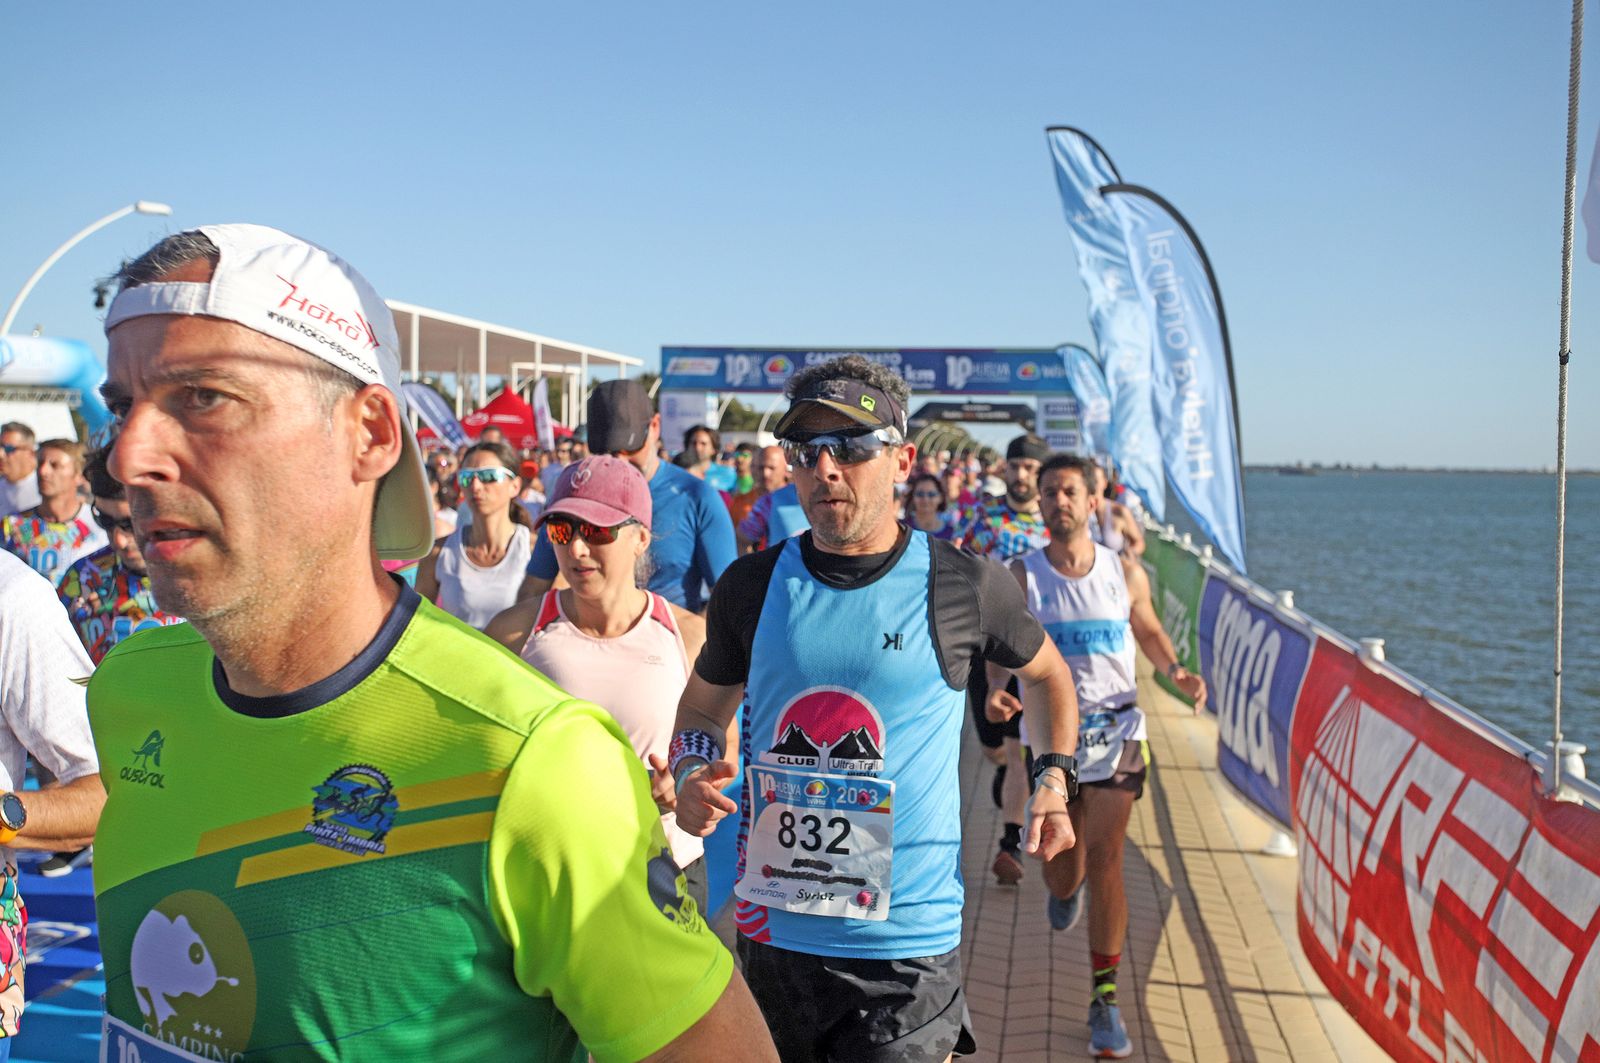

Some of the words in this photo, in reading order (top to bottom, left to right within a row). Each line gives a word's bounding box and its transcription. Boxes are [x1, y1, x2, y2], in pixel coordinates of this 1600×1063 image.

[30, 546, 58, 571] 10
[777, 755, 816, 766] CLUB
[832, 759, 855, 770] Ultra
[858, 760, 879, 771] Trail
[775, 781, 801, 797] HUELVA
[778, 810, 851, 856] 832
